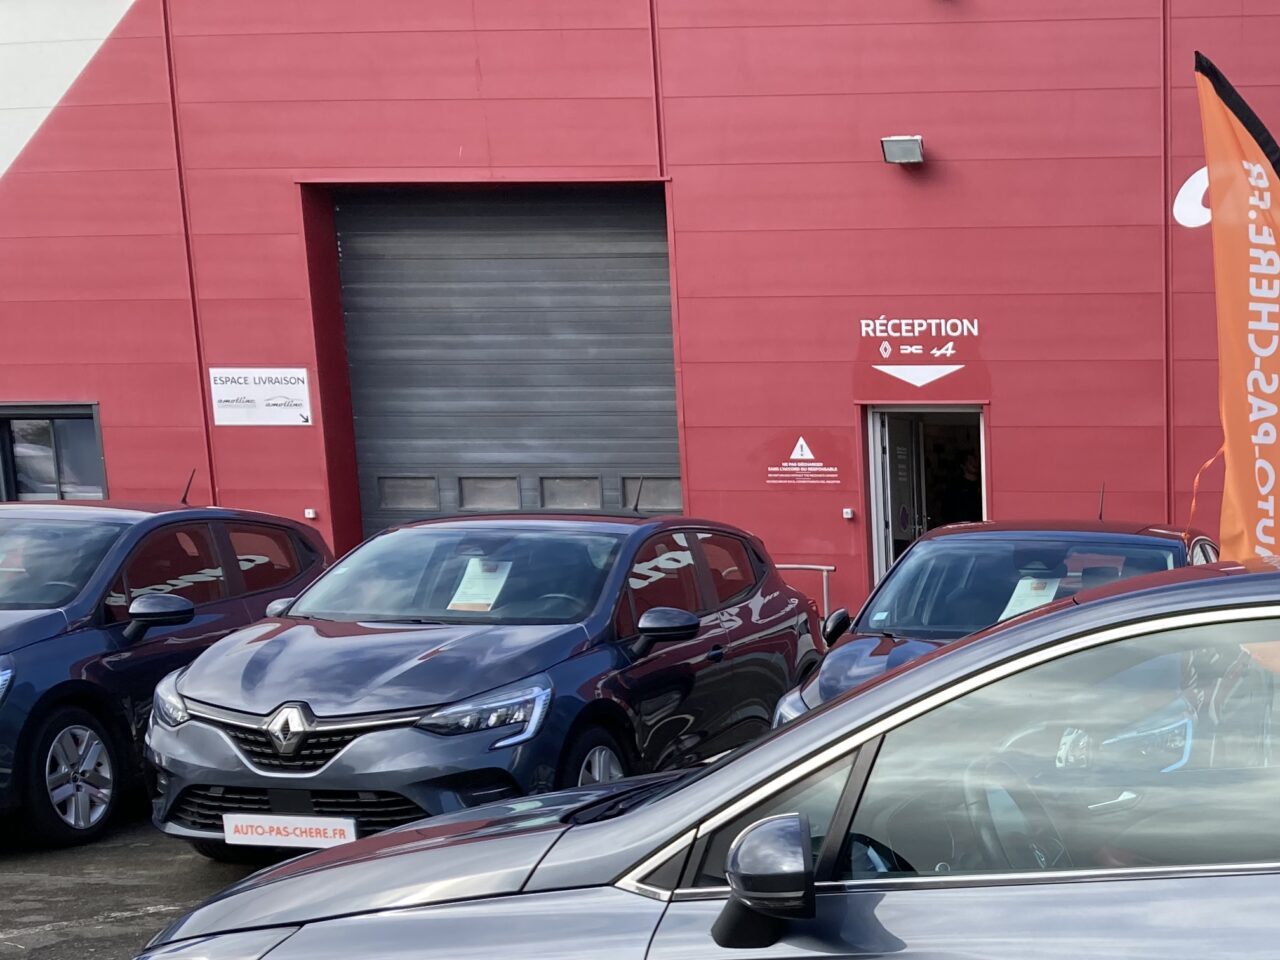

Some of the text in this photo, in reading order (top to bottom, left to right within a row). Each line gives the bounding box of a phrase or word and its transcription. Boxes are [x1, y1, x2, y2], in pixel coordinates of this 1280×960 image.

[860, 315, 979, 337] RÉCEPTION
[213, 376, 305, 385] ESPACE LIVRAISON
[233, 824, 347, 840] AUTO-PAS-CHERE.FR
